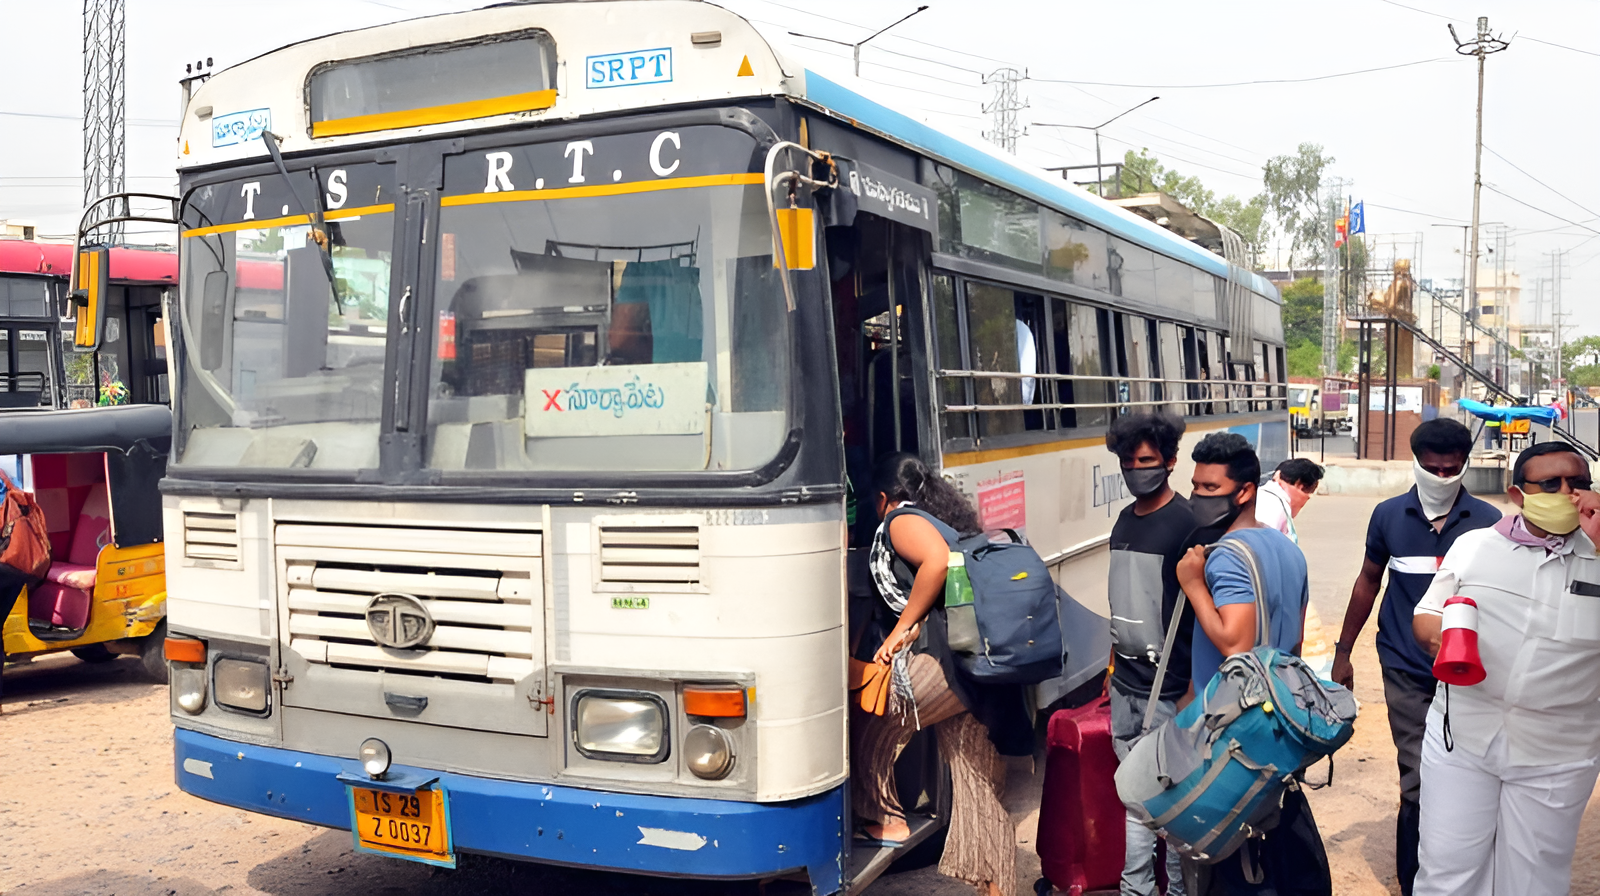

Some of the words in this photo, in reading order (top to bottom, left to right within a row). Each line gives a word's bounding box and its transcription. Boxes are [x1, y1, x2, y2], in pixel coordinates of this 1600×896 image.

[591, 54, 667, 84] SRPT
[371, 790, 391, 813] TS
[399, 795, 420, 818] 29
[388, 819, 431, 846] 0037
